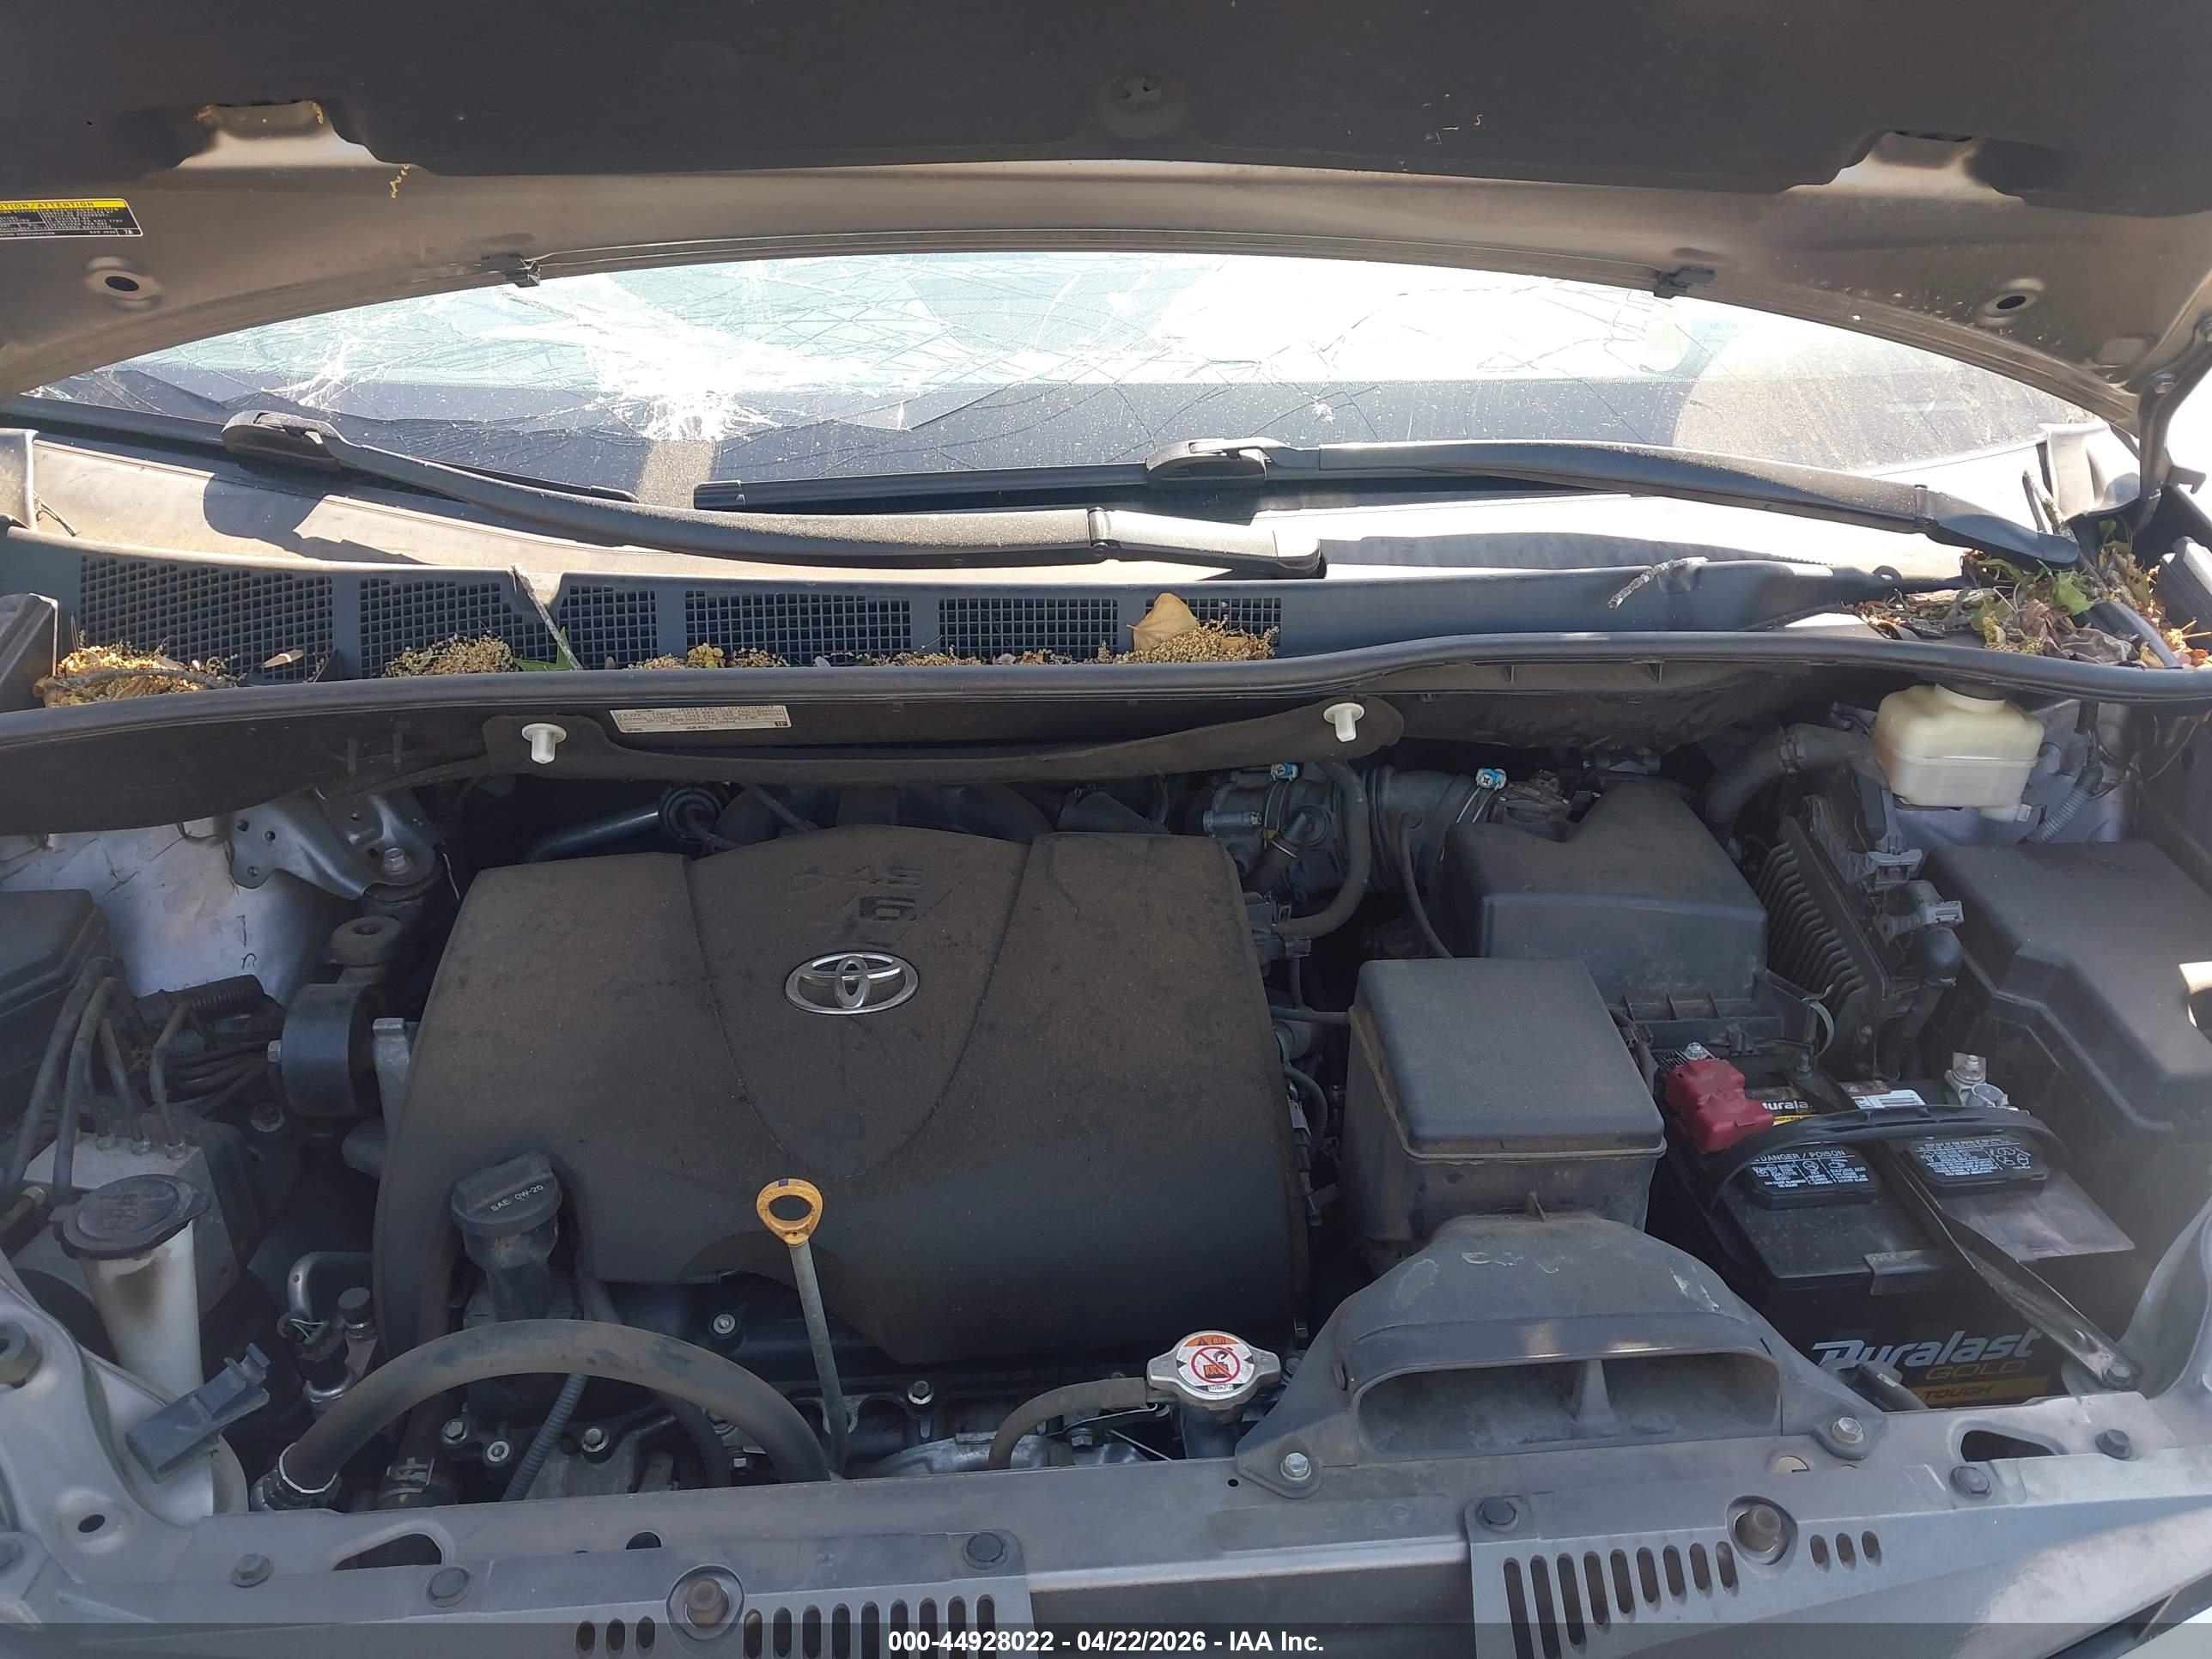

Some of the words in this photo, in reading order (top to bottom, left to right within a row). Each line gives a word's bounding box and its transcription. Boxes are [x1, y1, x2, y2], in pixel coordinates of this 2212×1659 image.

[1808, 1149, 1846, 1159] POISON
[489, 1199, 512, 1212] SAE
[514, 1184, 544, 1200] 0W-20
[1812, 1327, 2043, 1368] Duralast
[1925, 1360, 2027, 1381] GOLD
[1923, 1385, 1996, 1401] TOUGH
